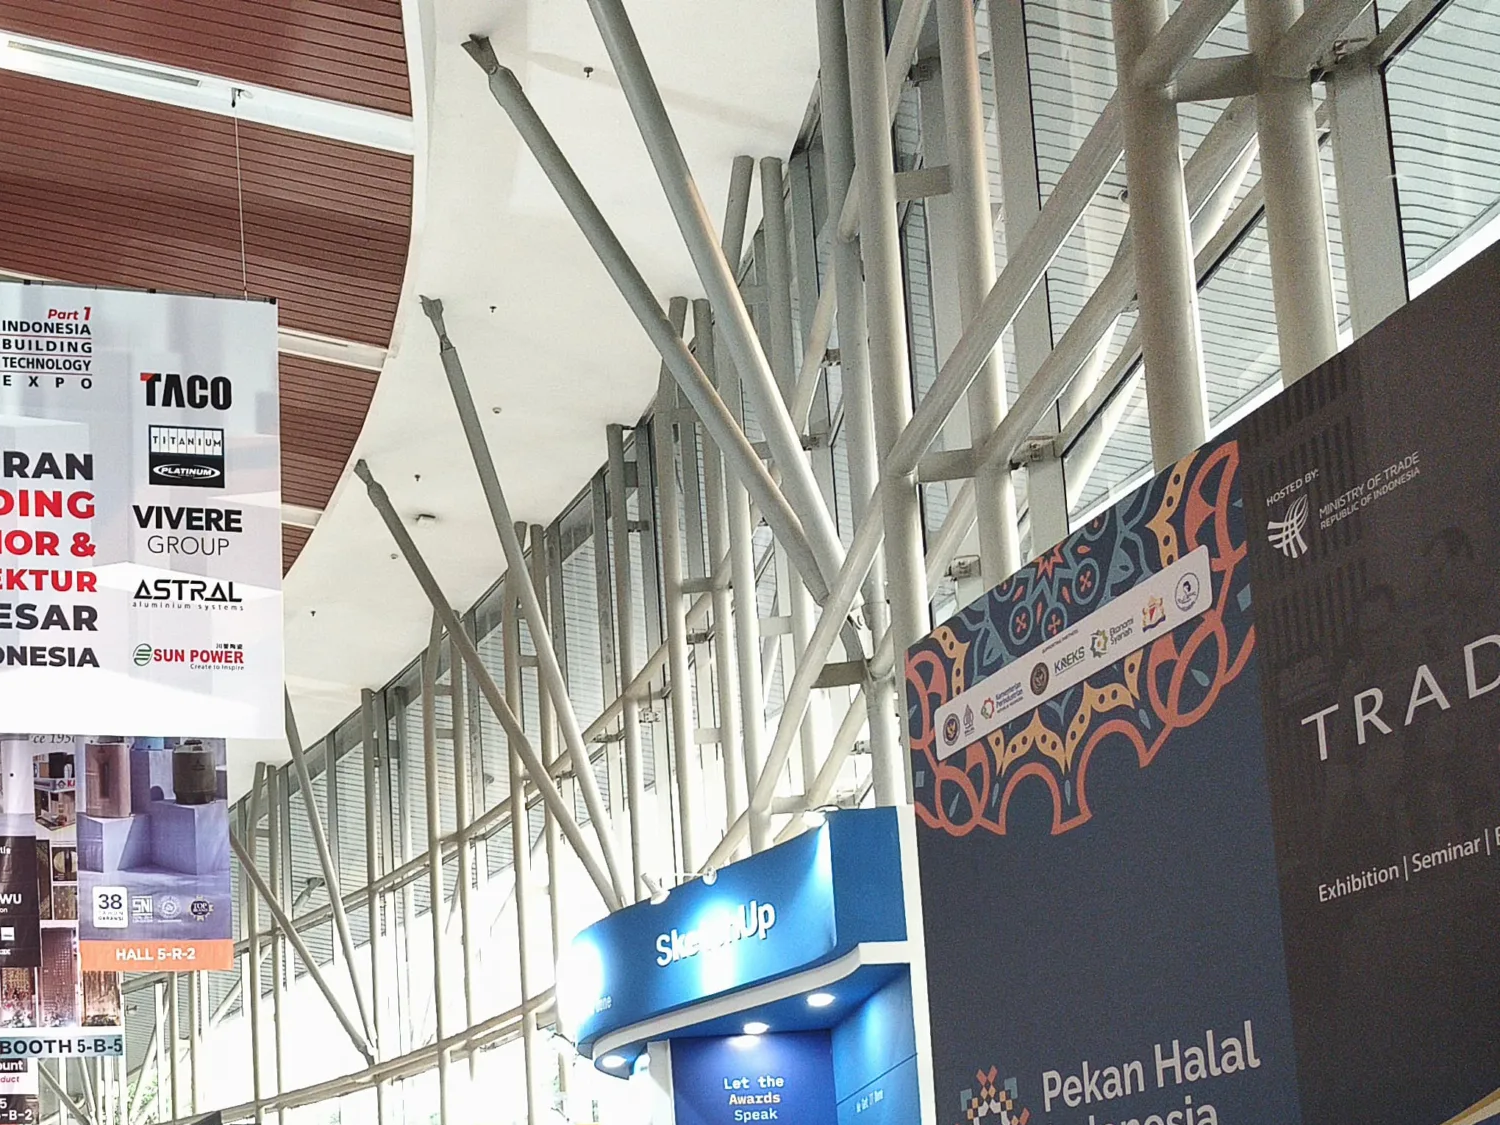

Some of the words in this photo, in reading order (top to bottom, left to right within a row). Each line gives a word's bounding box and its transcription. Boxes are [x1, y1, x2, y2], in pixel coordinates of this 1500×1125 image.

[48, 309, 79, 320] Part
[84, 307, 92, 321] 1
[2, 320, 91, 335] INDONESIA
[2, 339, 92, 353] BUILDING
[2, 357, 91, 371] TECHNOLOGY
[140, 373, 232, 410] TACO
[153, 436, 221, 447] TITANIUM
[161, 467, 212, 476] PLATINUM
[1319, 483, 1365, 519] MINISTRY
[1367, 473, 1382, 491] OF
[1383, 451, 1420, 481] TRADE
[1266, 479, 1303, 507] HOSTED
[1320, 501, 1359, 530] REPUBLIC
[1360, 494, 1372, 507] OF
[1373, 467, 1420, 501] INDONESIA
[132, 505, 242, 532] VIVERE
[71, 532, 96, 557] &
[148, 535, 229, 555] GROUP
[134, 579, 242, 602] ASTRAL
[198, 603, 244, 611] systems
[154, 649, 185, 662] SUN
[190, 650, 244, 663] POWER
[1318, 864, 1400, 903] Exhibition
[1411, 837, 1481, 873] Seminar
[98, 894, 122, 909] 38
[656, 901, 775, 967] SkehUp
[115, 947, 154, 961] HALL
[157, 947, 196, 961] 5-R-2
[0, 1039, 72, 1055] BOOTH
[77, 1038, 123, 1053] 5-B-5
[1042, 1060, 1144, 1113] Pekan
[1154, 1019, 1261, 1088] Halal
[724, 1077, 749, 1089] Let
[758, 1075, 784, 1088] the
[0, 1099, 7, 1109] 5
[729, 1092, 781, 1104] Awards
[734, 1108, 778, 1122] Speak
